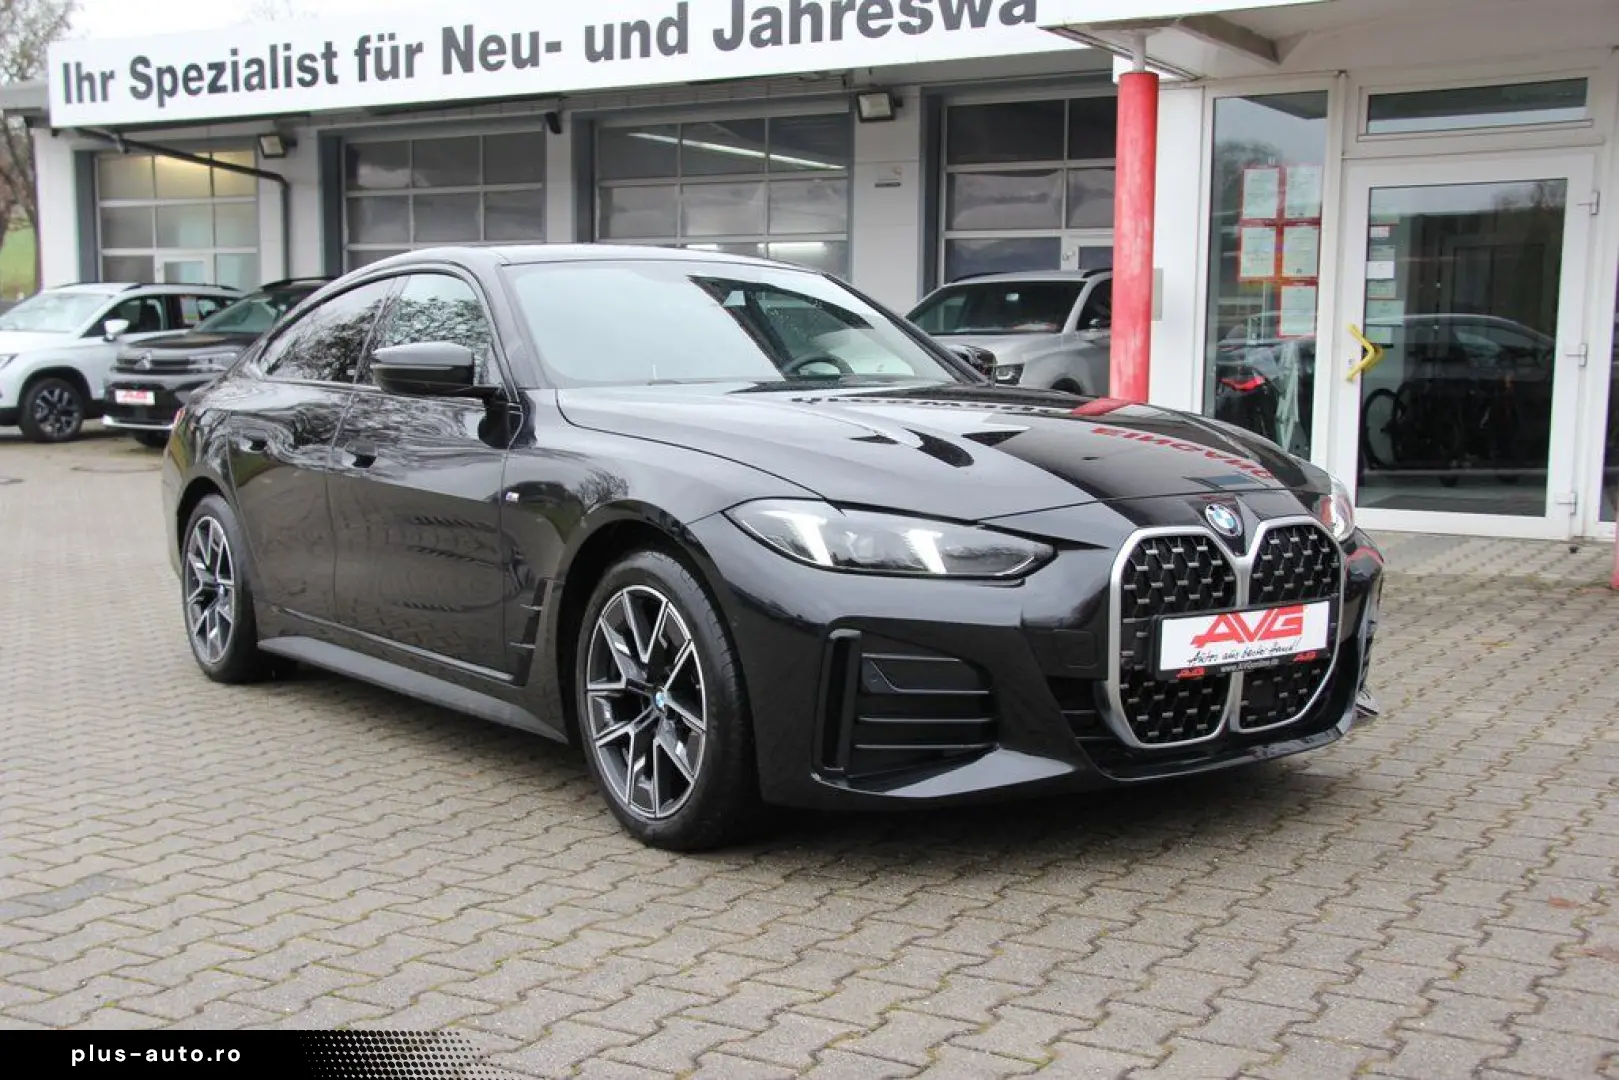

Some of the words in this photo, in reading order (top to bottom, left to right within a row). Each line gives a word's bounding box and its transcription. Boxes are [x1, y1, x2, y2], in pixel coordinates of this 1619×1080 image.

[62, 61, 115, 104] Ihr
[129, 41, 339, 108] Spezialist
[354, 33, 424, 82] für
[441, 24, 562, 75] Neu-
[584, 1, 689, 63] und
[1190, 603, 1304, 648] AVG
